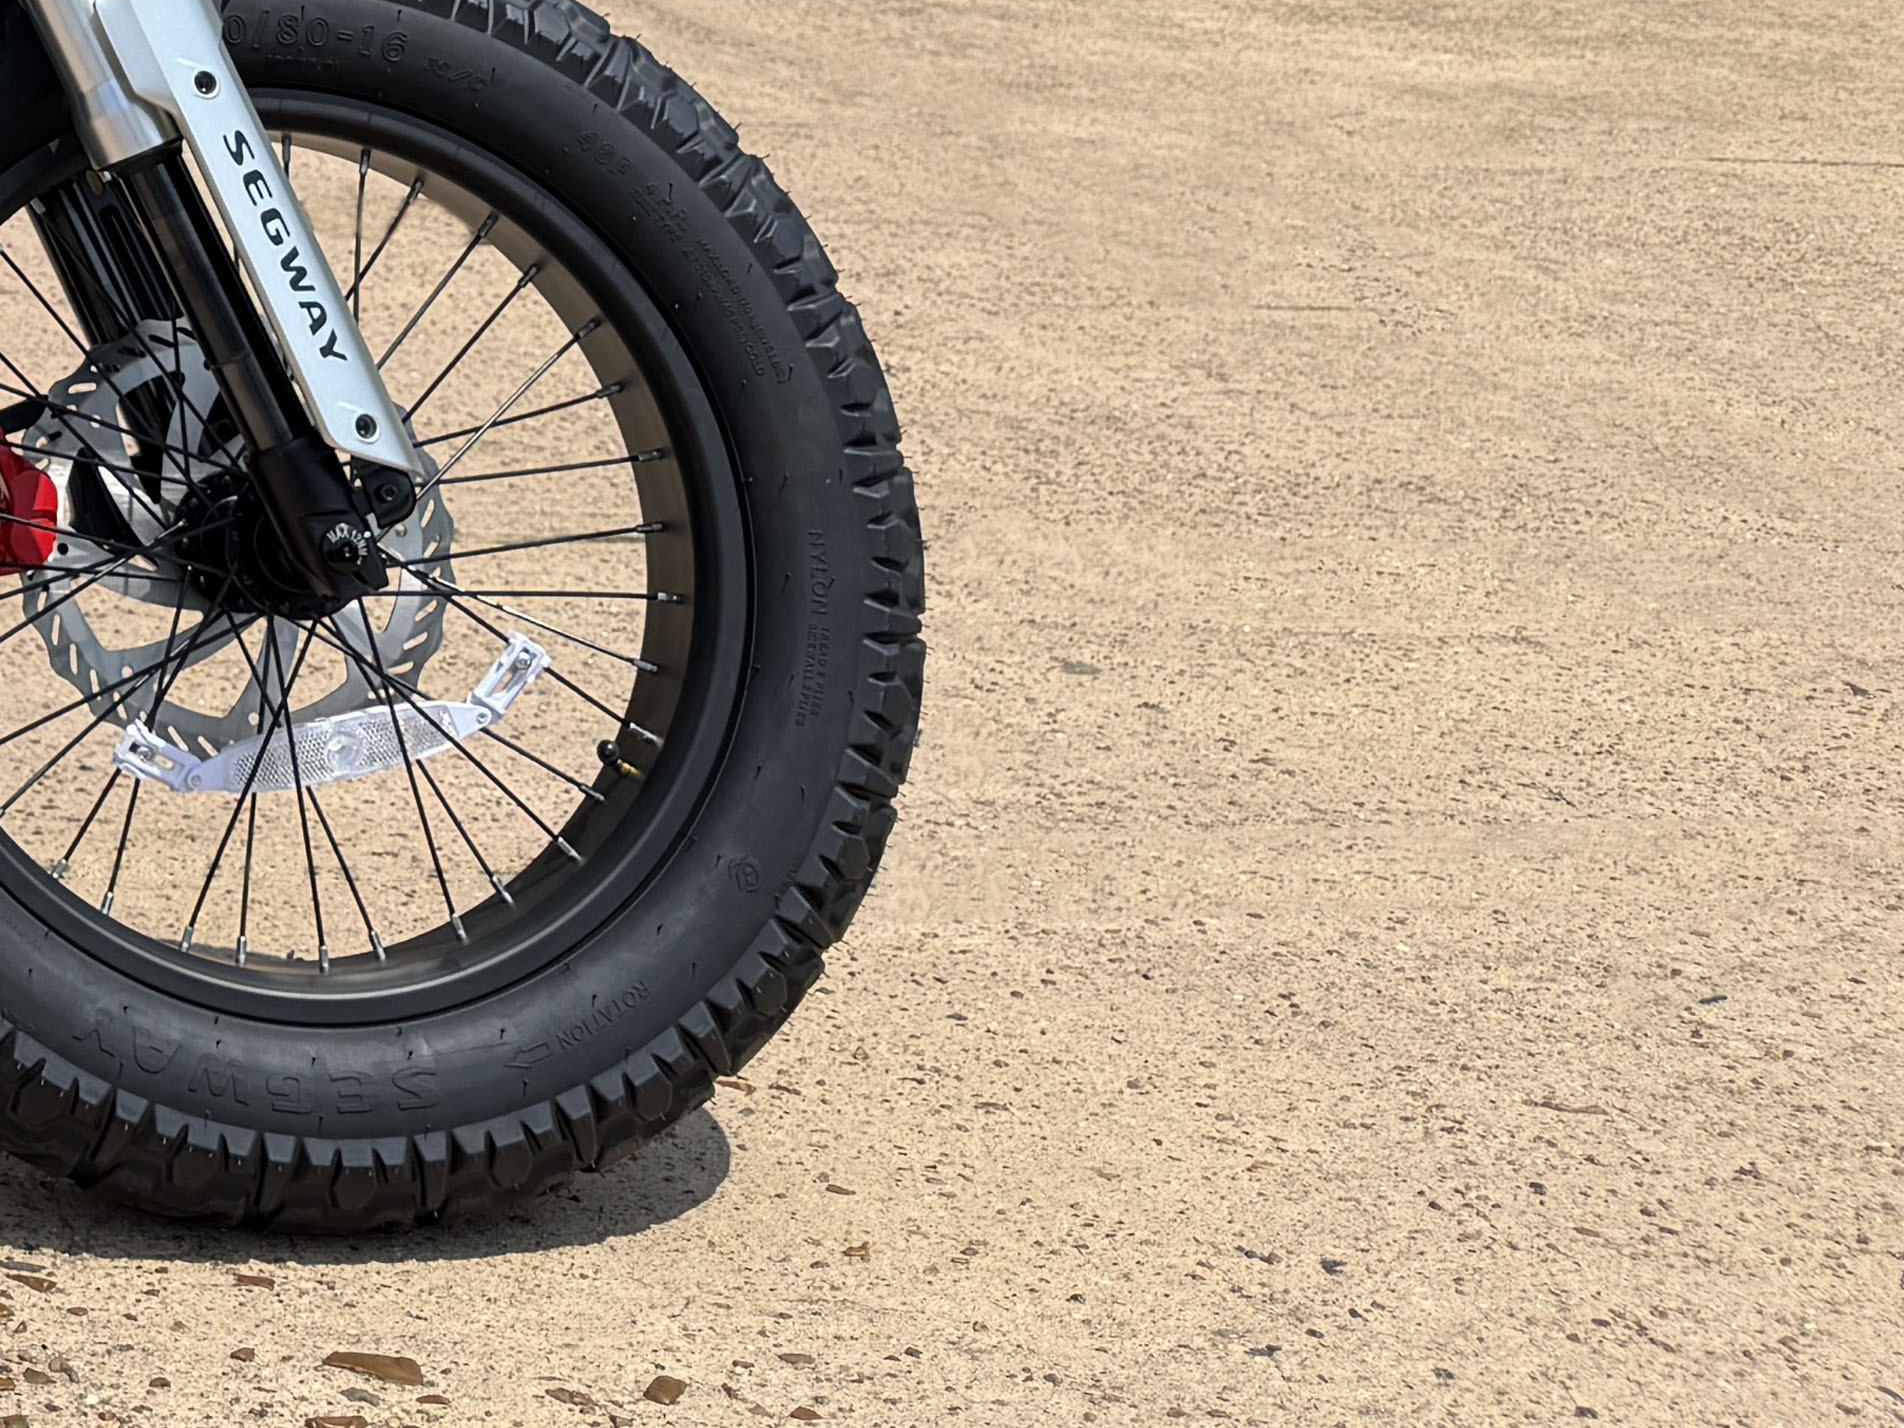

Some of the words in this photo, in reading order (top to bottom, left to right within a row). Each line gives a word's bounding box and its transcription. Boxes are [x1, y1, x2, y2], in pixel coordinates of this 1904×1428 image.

[222, 129, 348, 361] SEGWAY
[72, 1005, 441, 1114] SEGWAY
[553, 981, 652, 1051] ROTATION
